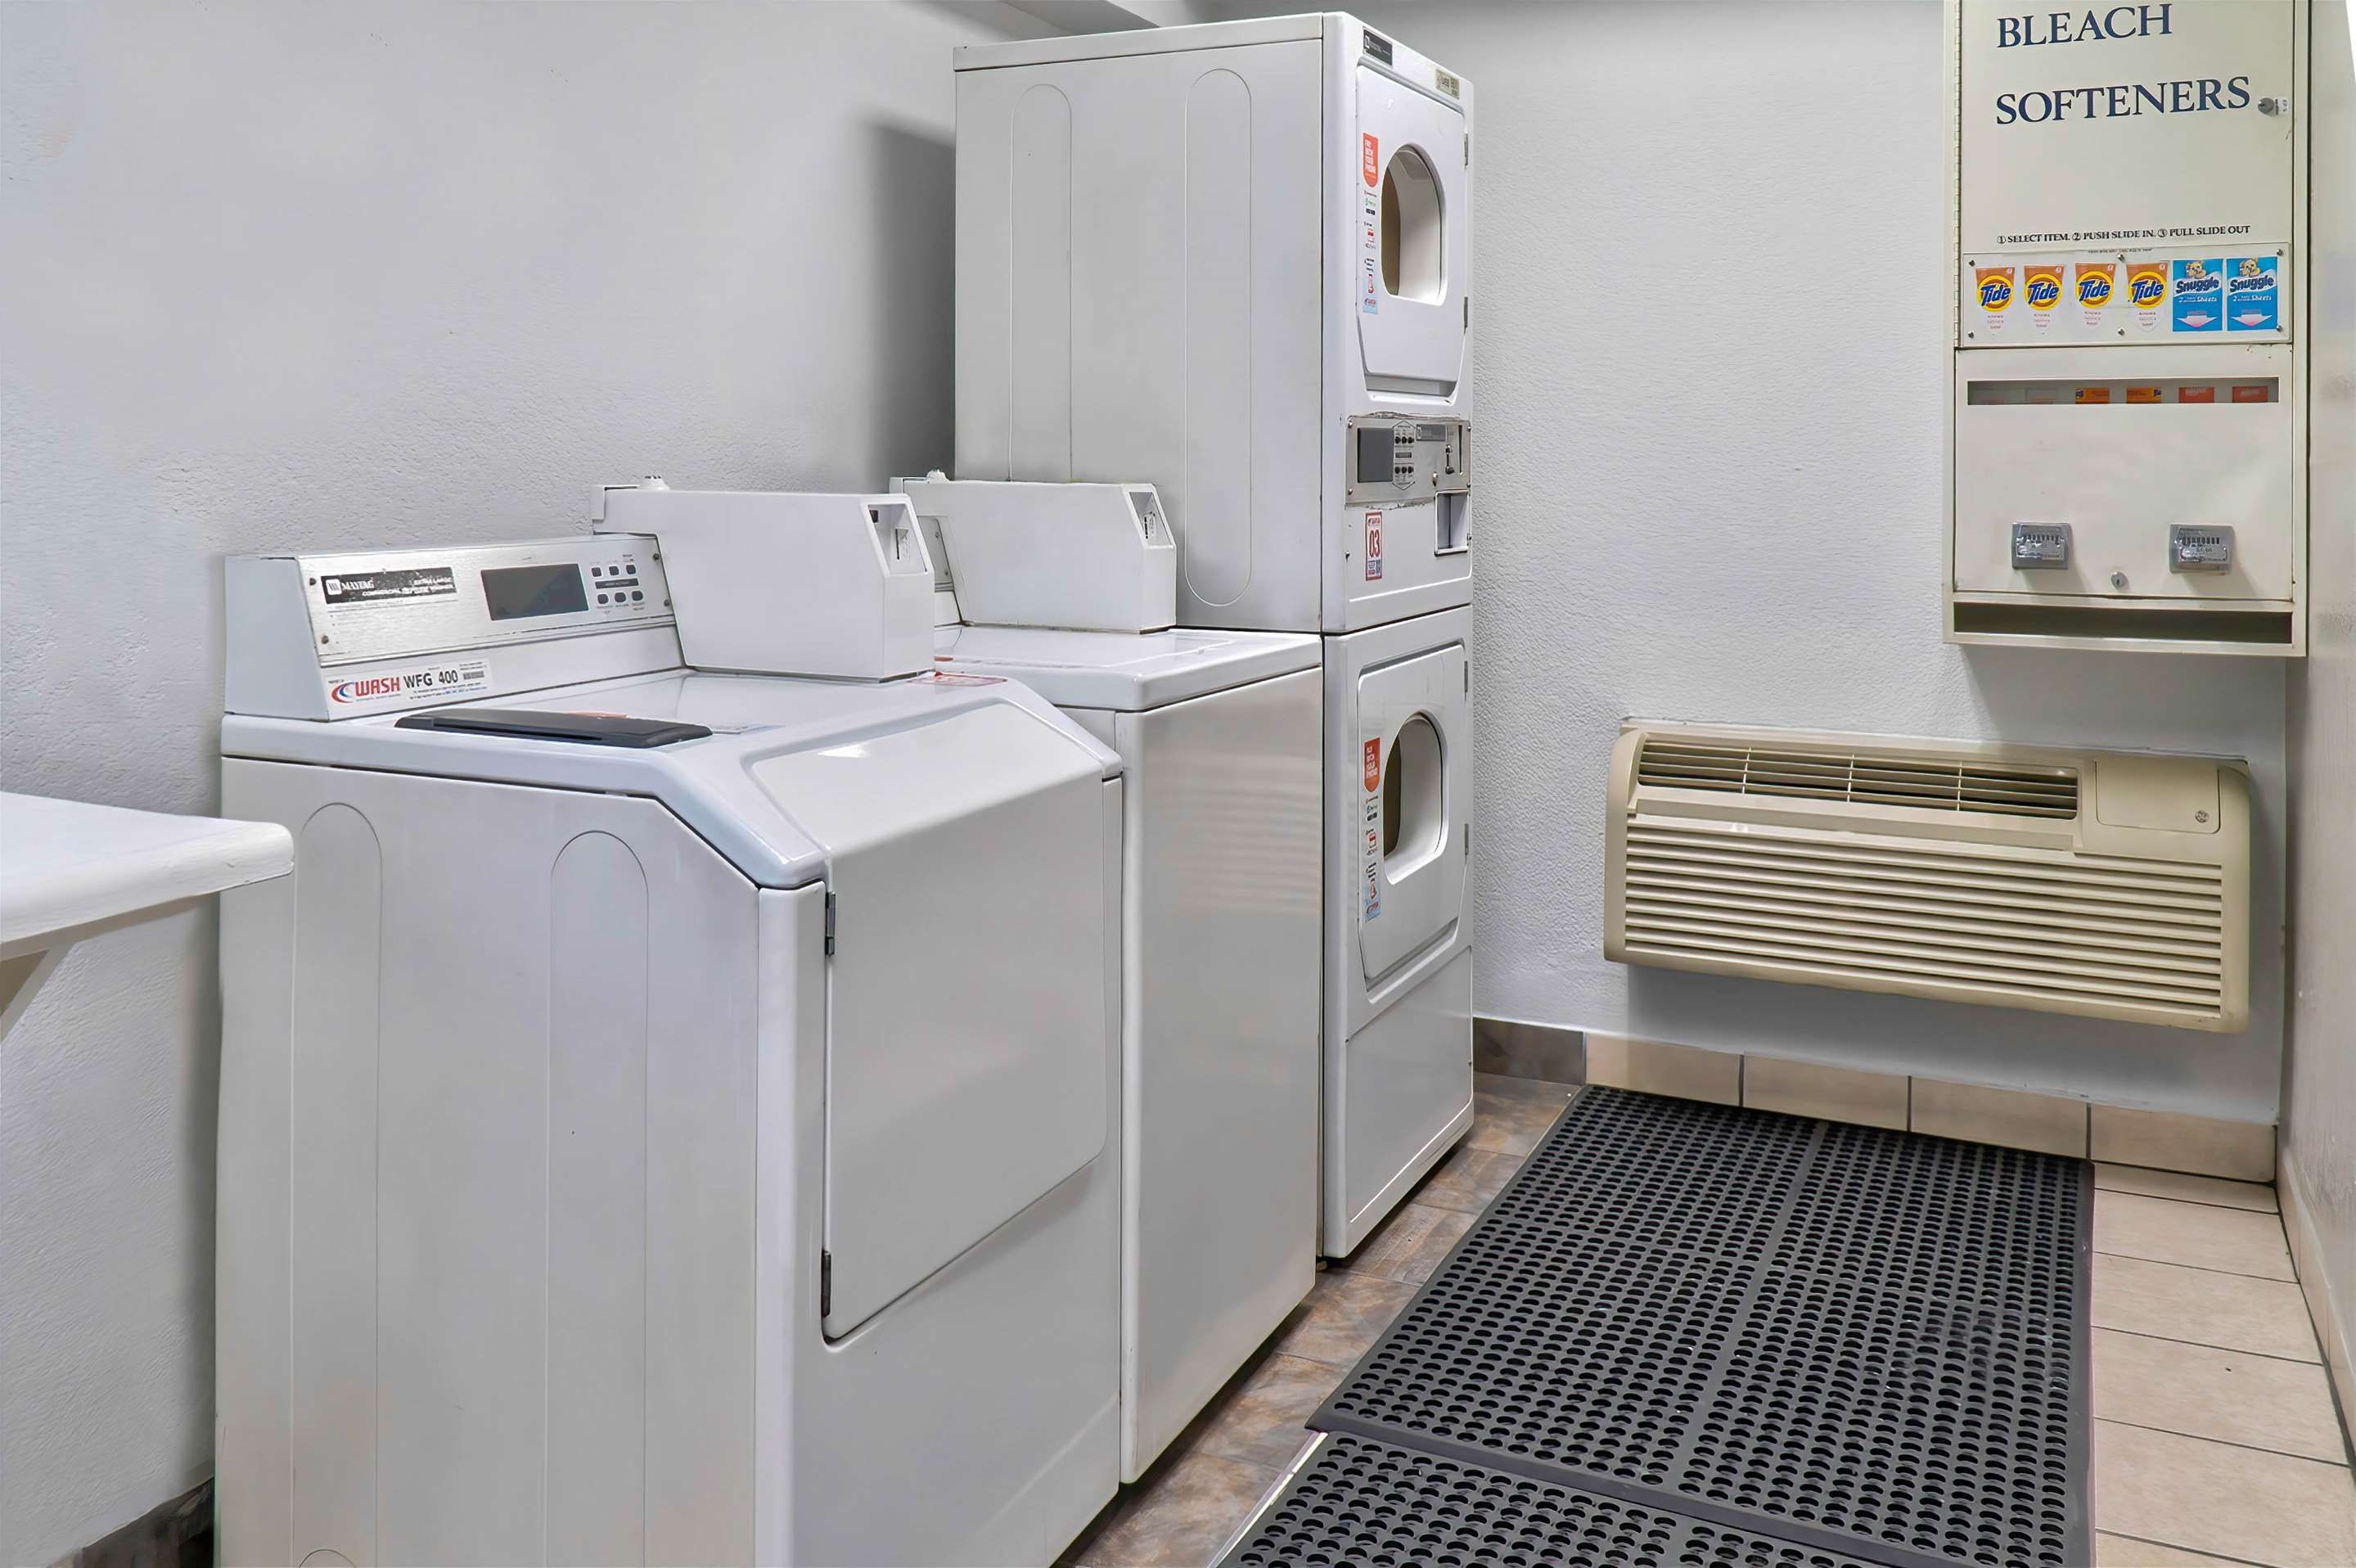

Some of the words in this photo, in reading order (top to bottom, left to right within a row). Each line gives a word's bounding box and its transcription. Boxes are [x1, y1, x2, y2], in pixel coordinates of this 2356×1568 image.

[1997, 3, 2172, 48] BLEACH
[1996, 76, 2250, 124] SOFTENERS
[2007, 233, 2042, 243] SELECT
[2083, 231, 2110, 240] PUSH
[2111, 230, 2140, 239] SLIDE
[2169, 228, 2195, 237] PULL
[2196, 226, 2226, 236] SLIDE
[2228, 225, 2250, 234] OUT
[1980, 283, 2011, 306] Tide
[2028, 282, 2060, 304] Tide
[2079, 279, 2110, 302] Tide
[2131, 279, 2165, 303] Tide
[2175, 277, 2220, 294] Snuggle
[2230, 275, 2274, 293] Snuggle
[1369, 529, 1381, 557] 03
[355, 676, 401, 697] WASH
[403, 672, 433, 688] WFG
[439, 669, 458, 684] 400
